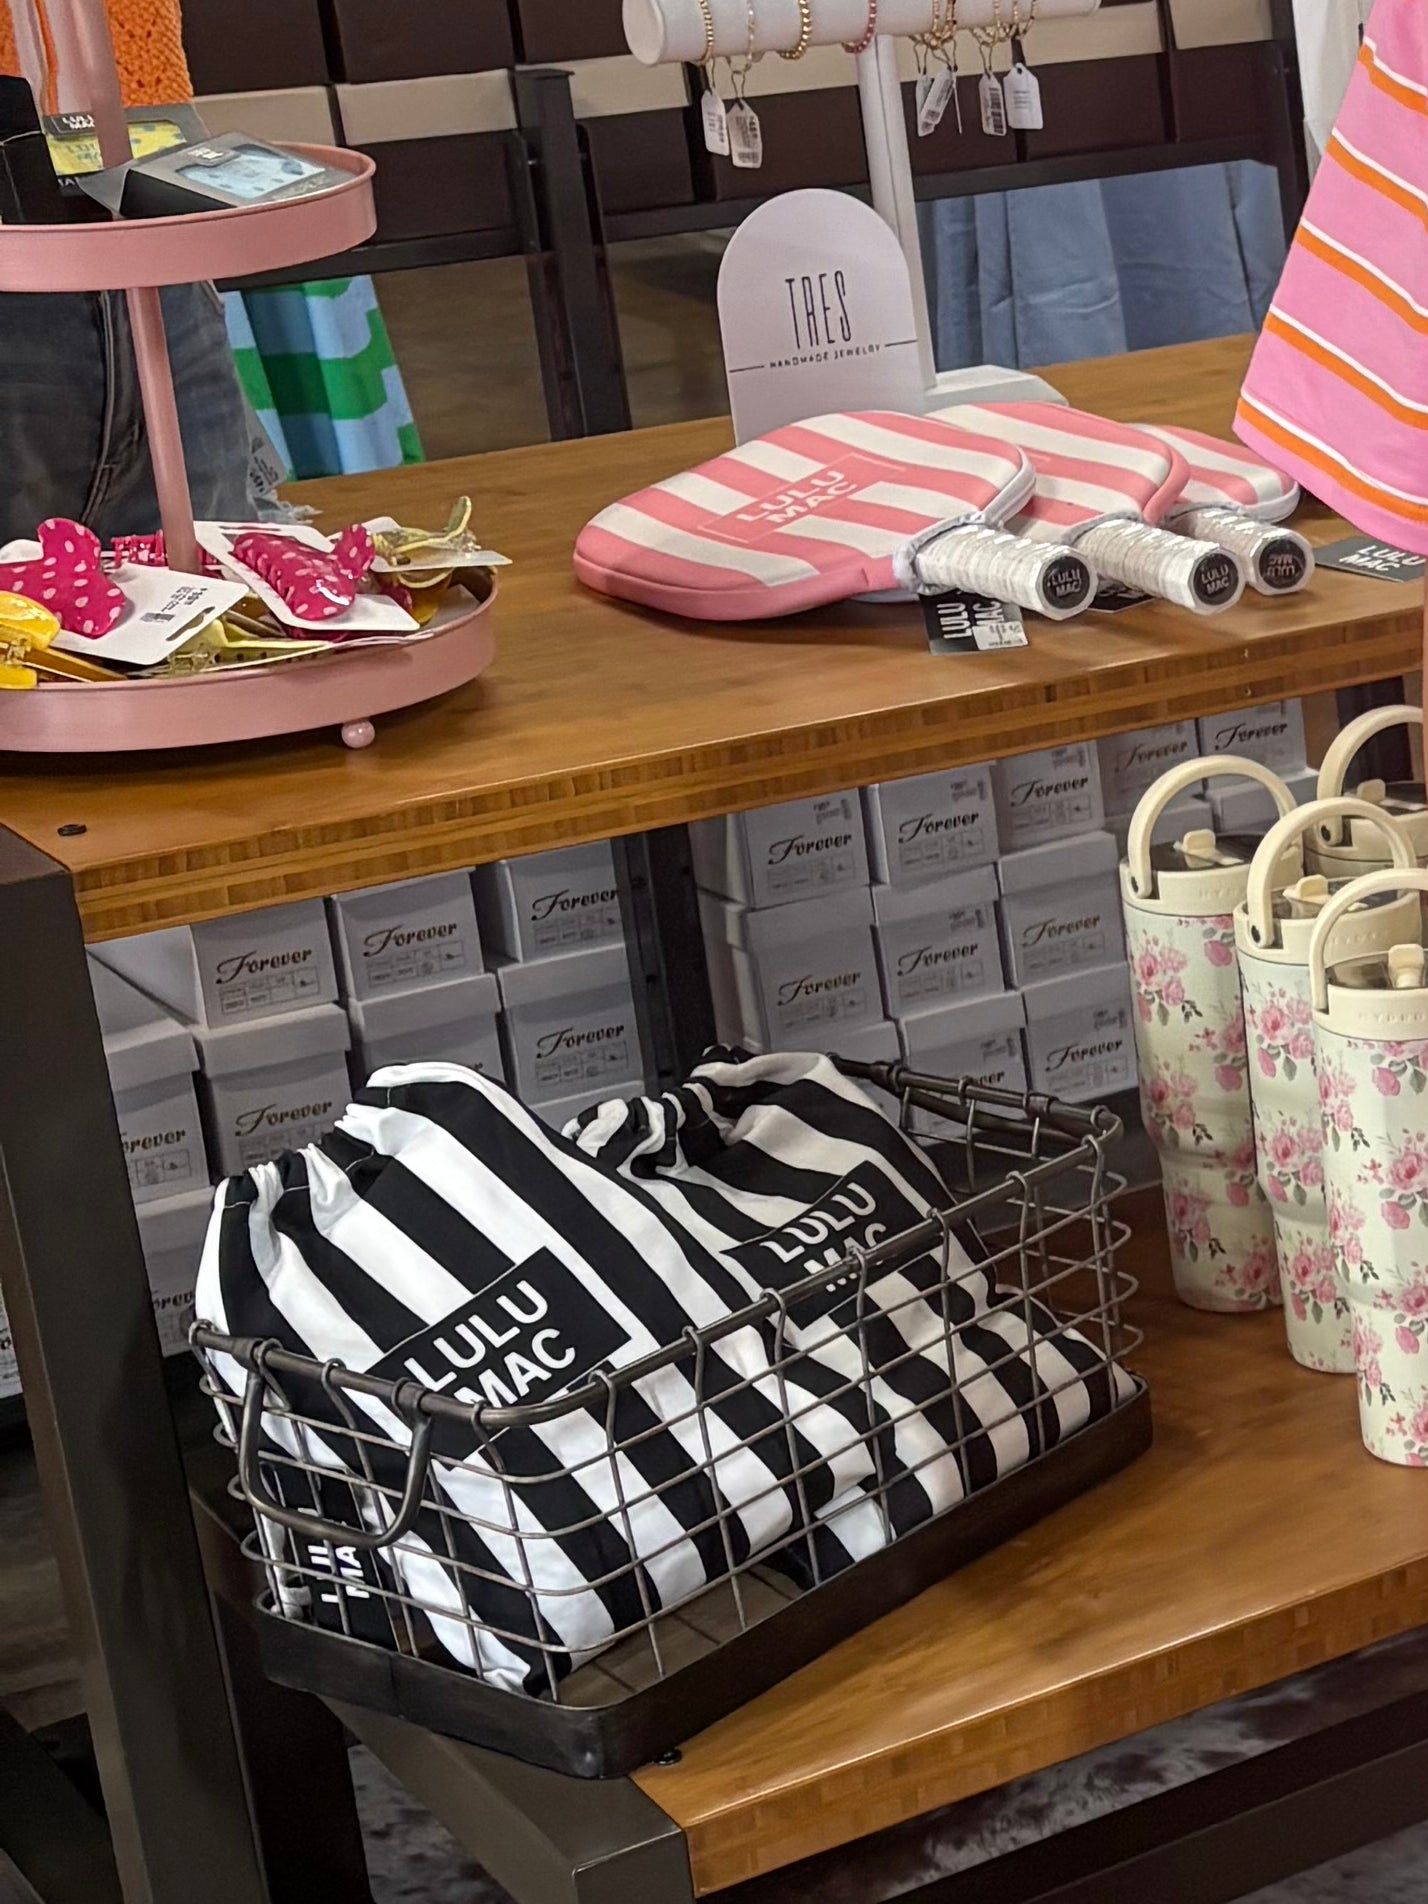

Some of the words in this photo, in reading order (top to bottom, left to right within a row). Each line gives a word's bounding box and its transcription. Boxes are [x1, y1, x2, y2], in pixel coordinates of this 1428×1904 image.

[785, 270, 851, 350] TRES
[769, 351, 829, 369] HANDMADE
[736, 470, 845, 522] LULU
[766, 483, 857, 524] MAC
[1339, 553, 1401, 572] MAC
[1357, 545, 1427, 566] LULU
[1056, 580, 1081, 597] MAC
[1201, 564, 1229, 585] LULU
[1206, 578, 1230, 595] MAC
[936, 602, 973, 640] LULU
[1010, 775, 1089, 807] Forever
[898, 810, 980, 844] Forever
[768, 832, 852, 865] Forever
[531, 888, 622, 921] Forever
[363, 919, 458, 958] Forever
[1022, 913, 1101, 947] Forever
[216, 948, 312, 985] Forever
[897, 941, 979, 976] Forever
[777, 970, 861, 1006] Forever
[535, 1022, 625, 1060] Forever
[1045, 1038, 1123, 1071] Forever
[234, 1099, 333, 1138] Forever
[758, 1181, 877, 1264] LULU
[404, 1279, 549, 1391] LULU
[453, 1328, 576, 1409] MAC
